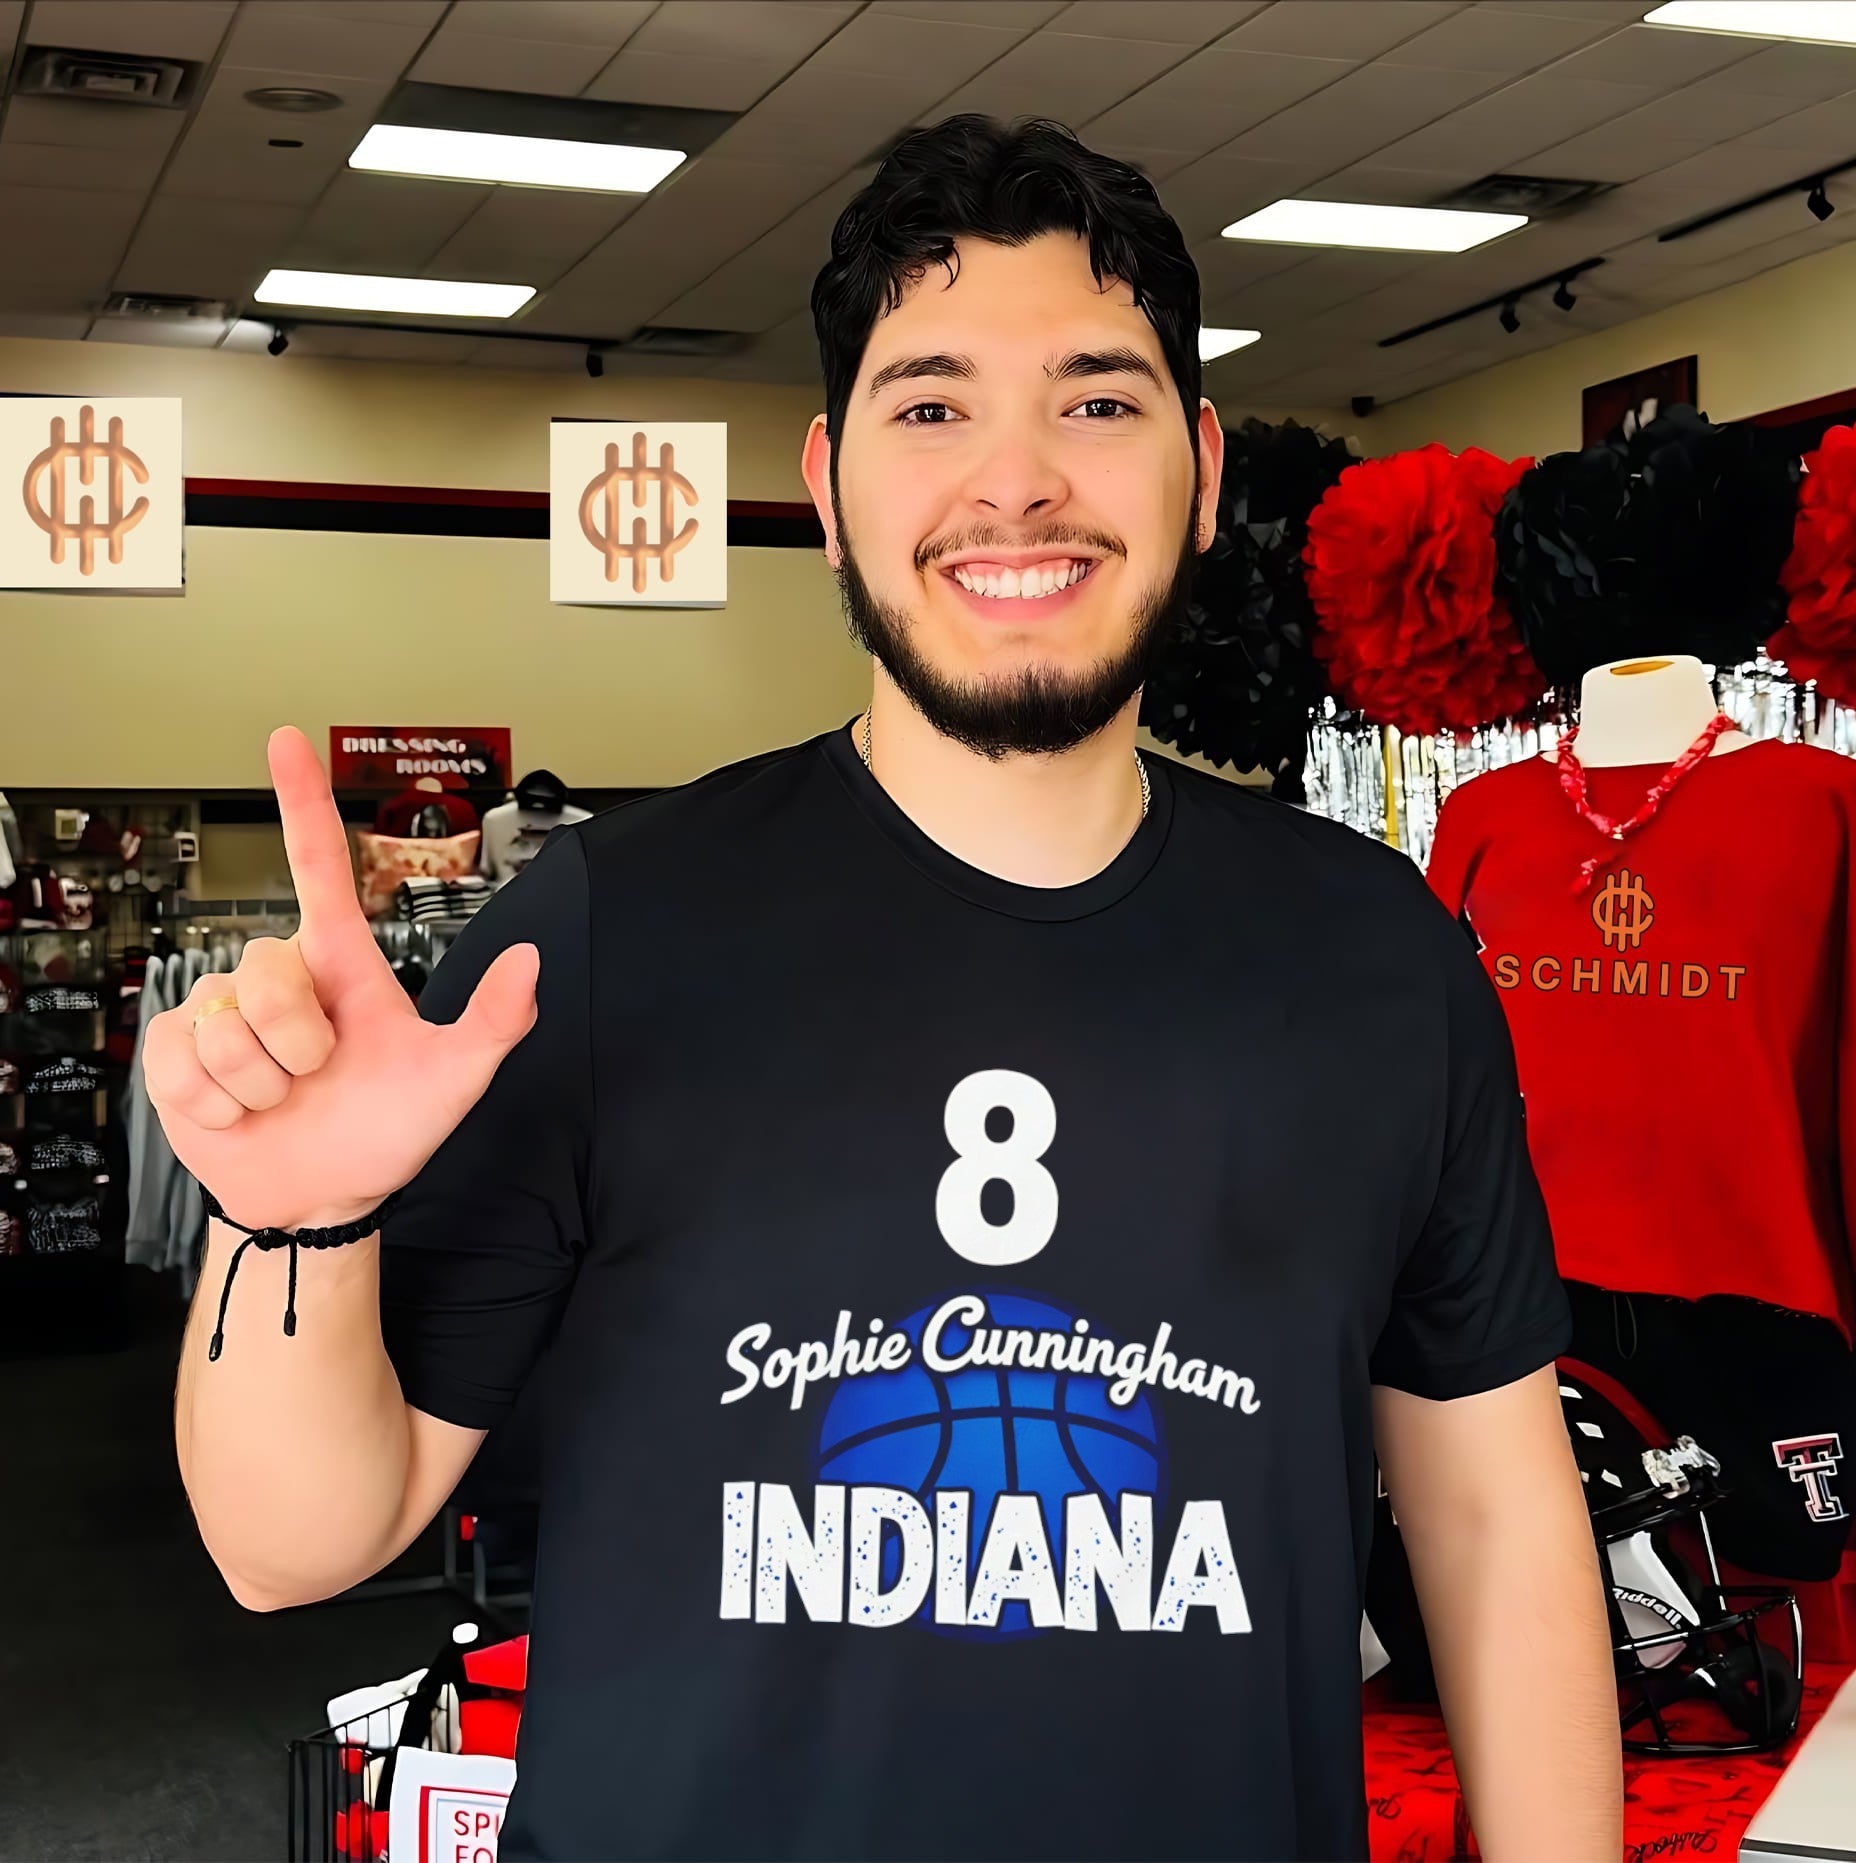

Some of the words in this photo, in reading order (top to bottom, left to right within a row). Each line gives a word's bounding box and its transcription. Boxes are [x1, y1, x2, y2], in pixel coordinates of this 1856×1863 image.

[342, 737, 467, 753] DRESSING
[396, 758, 488, 775] ROOMS
[1494, 953, 1747, 1001] SCHMIDT
[935, 1068, 1060, 1267] 8
[720, 1309, 912, 1411] Sophie
[921, 1294, 1262, 1415] Cunningham
[719, 1480, 1253, 1635] INDIANA
